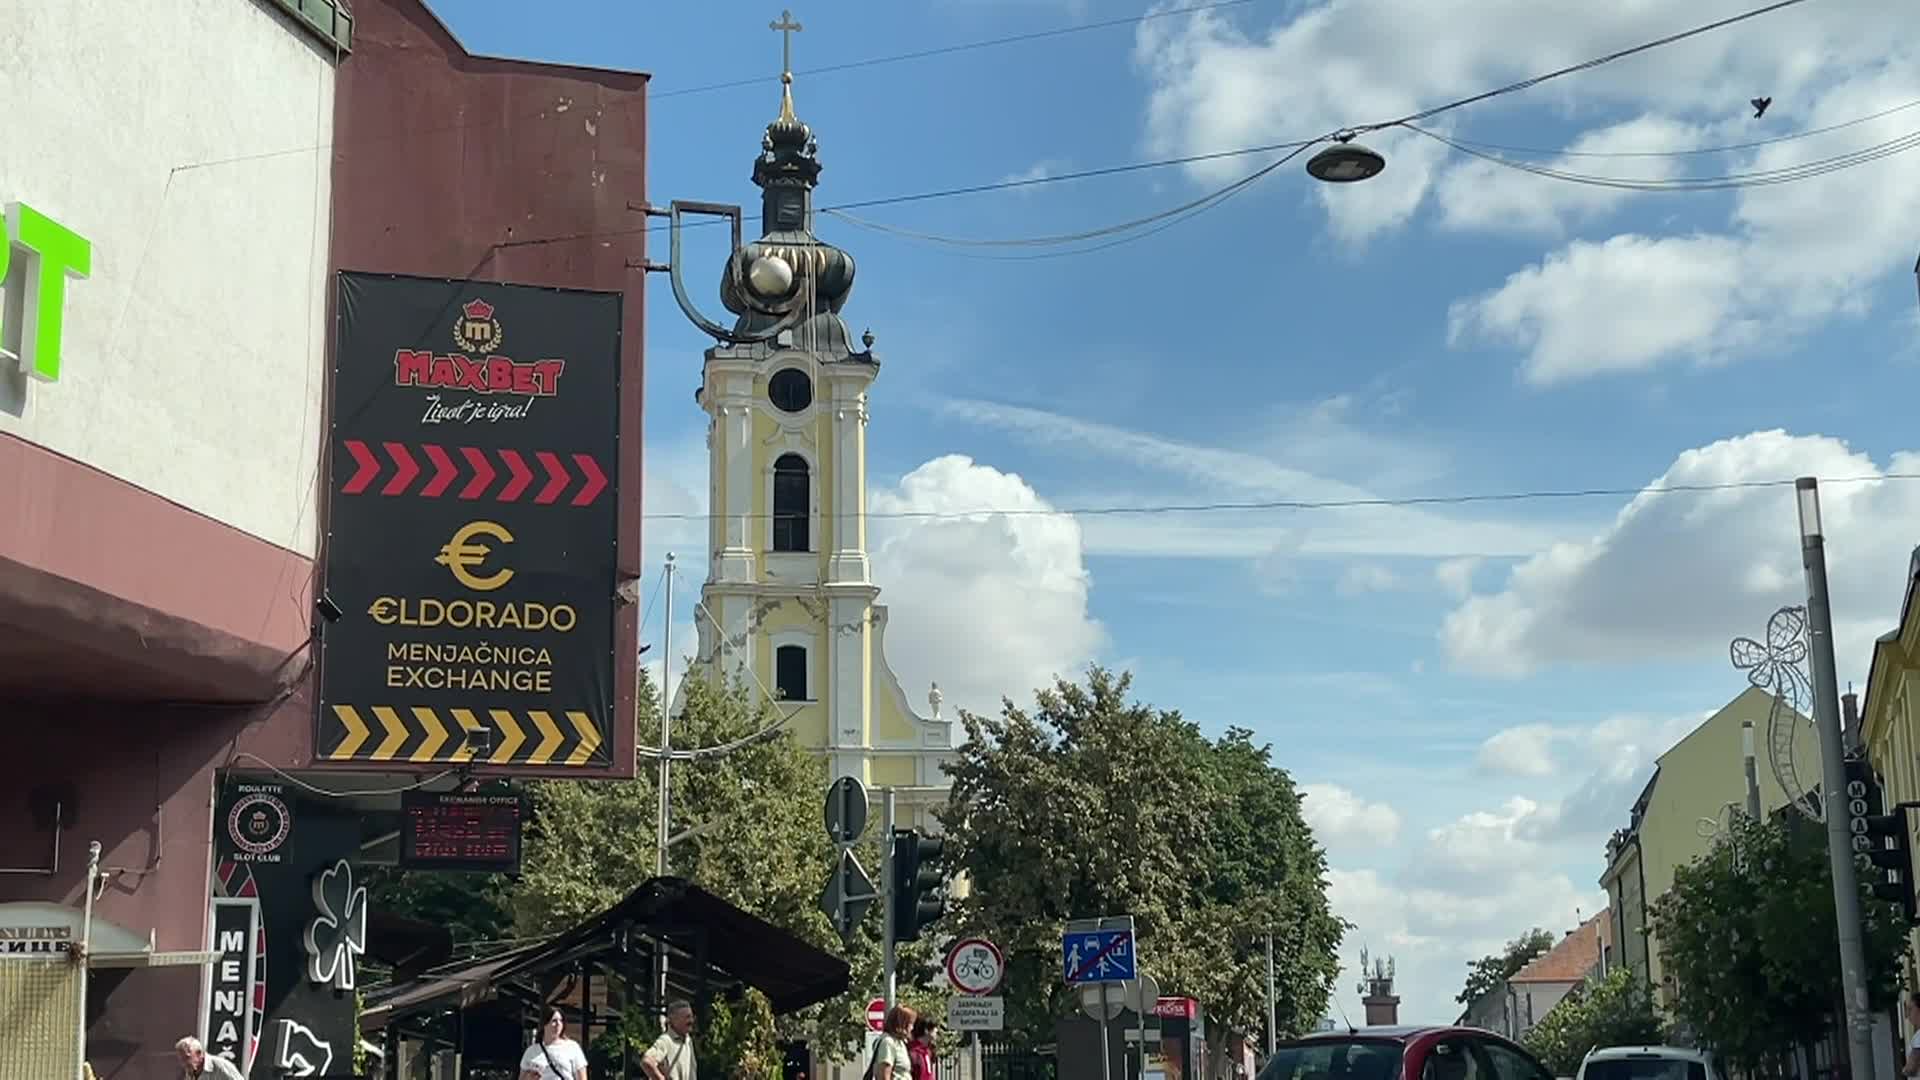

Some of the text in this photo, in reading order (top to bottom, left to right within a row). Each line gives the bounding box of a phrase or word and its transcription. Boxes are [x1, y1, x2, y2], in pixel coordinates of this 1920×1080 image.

[0, 200, 92, 382] T
[422, 393, 535, 425] Život je igra!
[387, 641, 552, 666] MENJAČNICA
[387, 666, 552, 693] EXCHANGE
[238, 785, 282, 794] ROULETTE
[233, 853, 281, 862] SLOT CLUB
